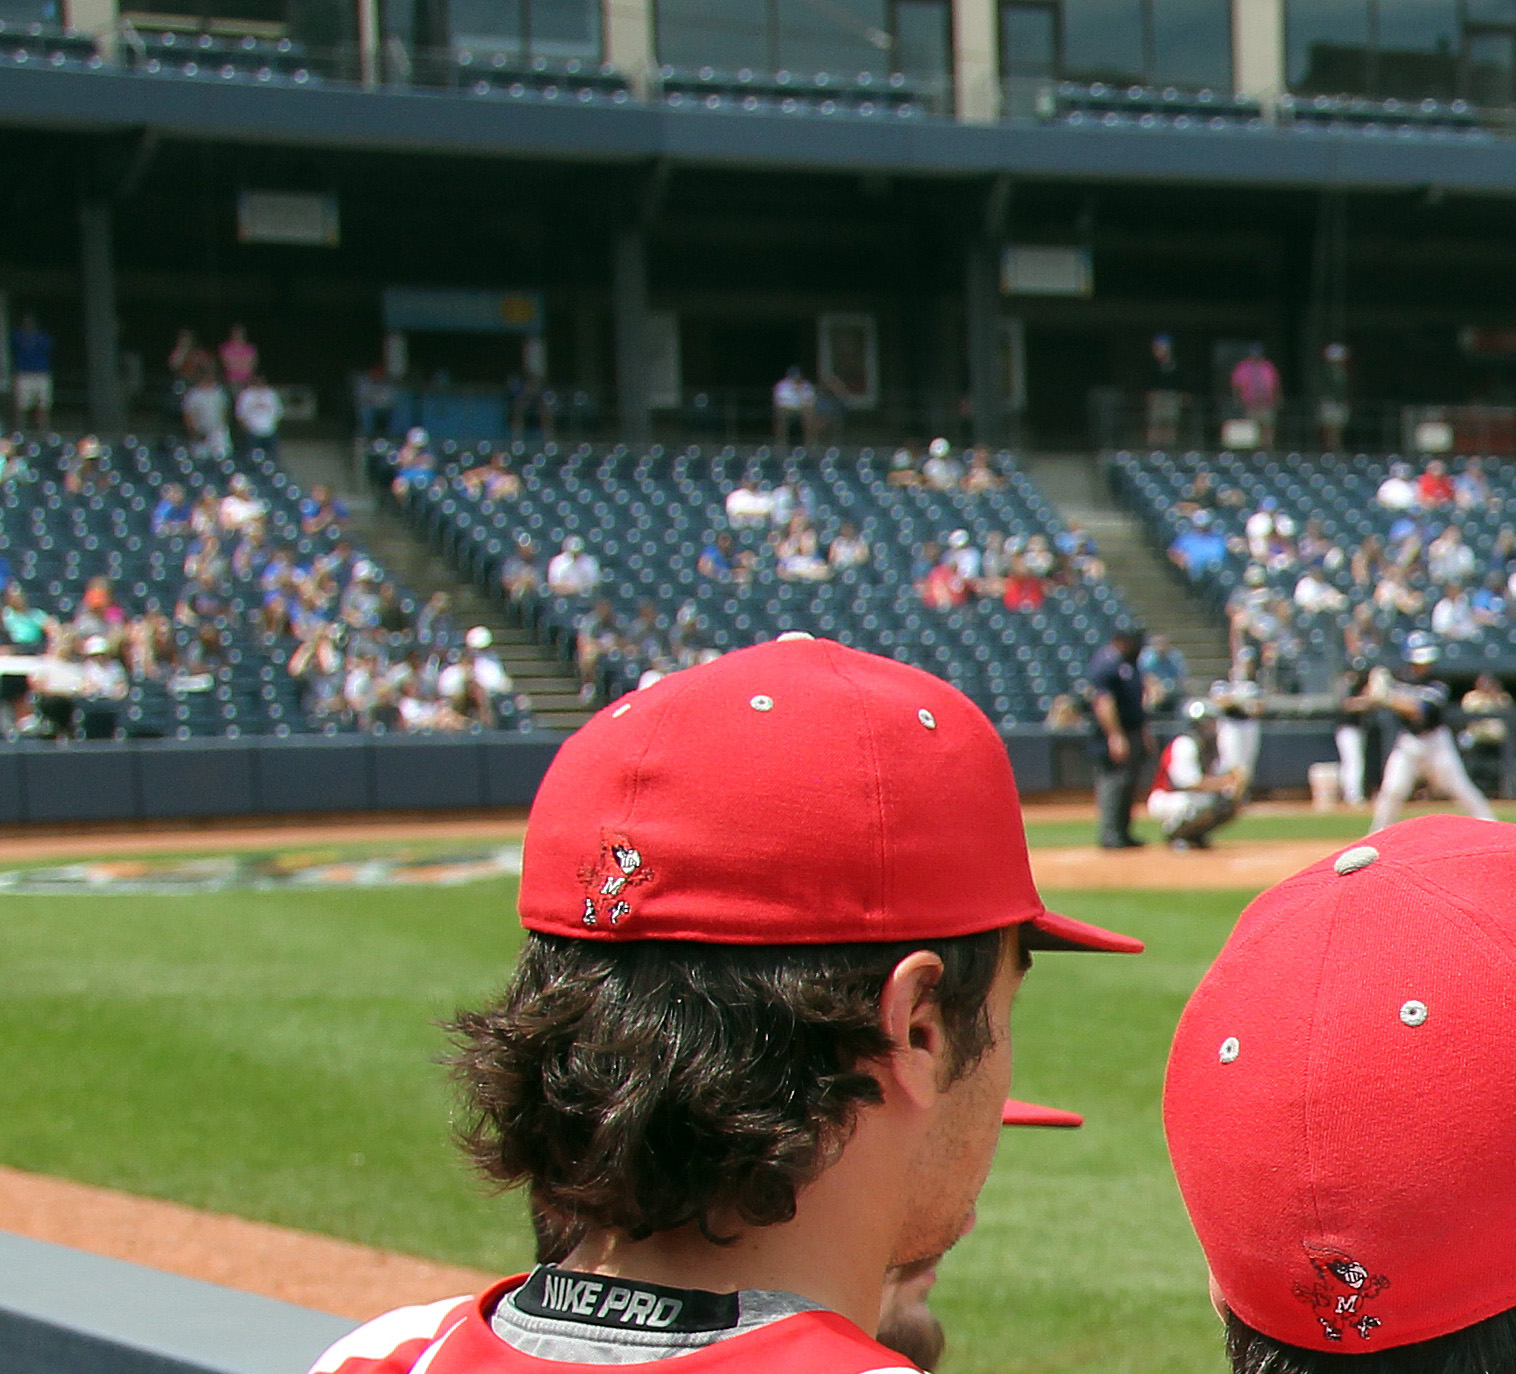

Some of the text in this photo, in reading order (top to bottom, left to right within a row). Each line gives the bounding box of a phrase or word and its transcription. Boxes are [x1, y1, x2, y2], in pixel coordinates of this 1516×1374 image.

[600, 876, 626, 895] M
[542, 1273, 683, 1328] NIKE PRO
[1335, 1294, 1360, 1314] M
